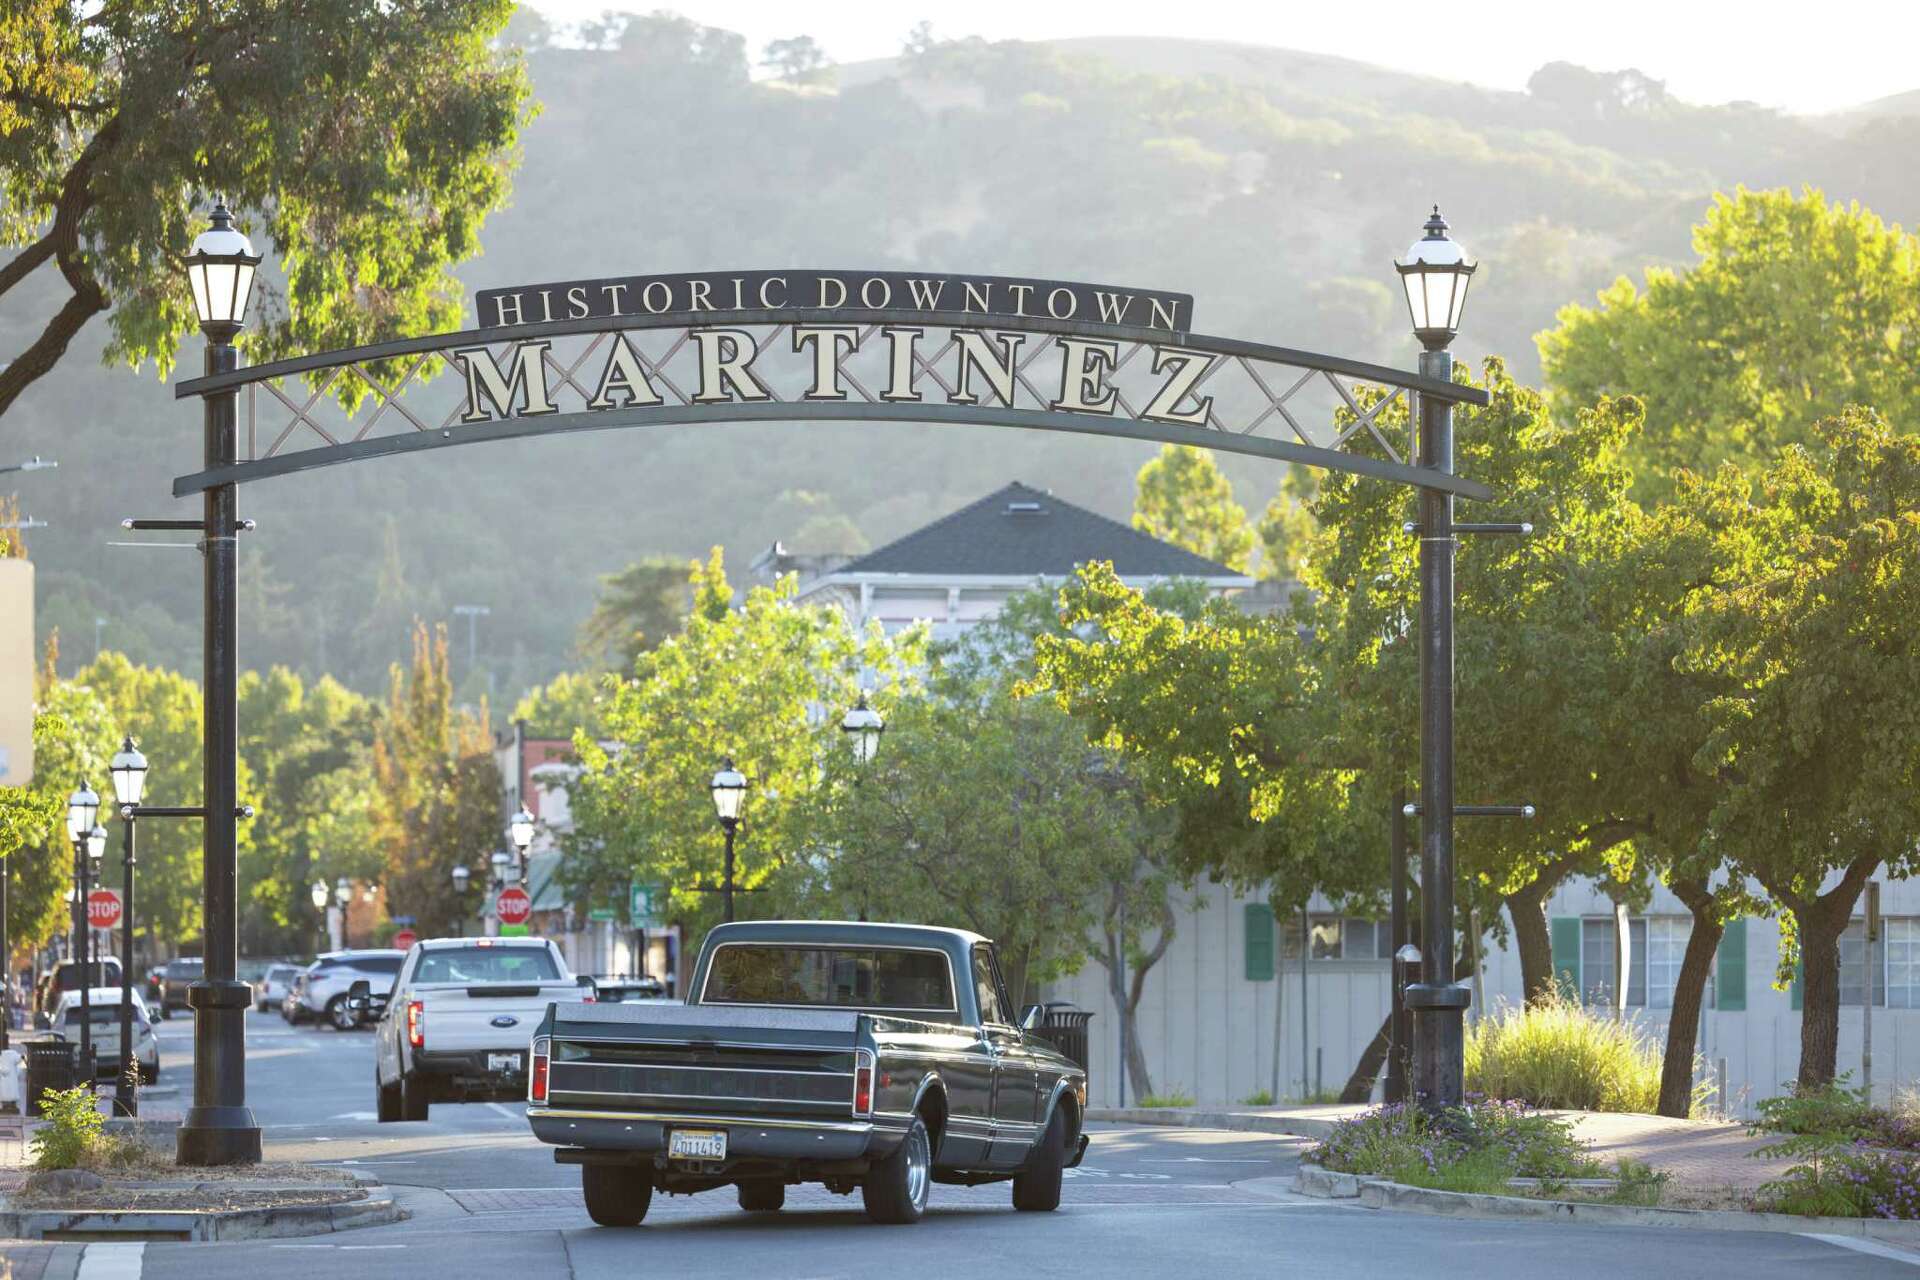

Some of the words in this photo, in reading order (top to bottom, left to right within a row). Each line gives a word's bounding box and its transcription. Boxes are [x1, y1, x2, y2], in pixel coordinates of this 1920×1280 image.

[492, 277, 788, 328] HISTORIC
[816, 277, 1180, 331] DOWNTOWN
[454, 325, 1218, 425] MARTINEZ
[88, 901, 120, 918] STOP
[498, 898, 529, 914] STOP
